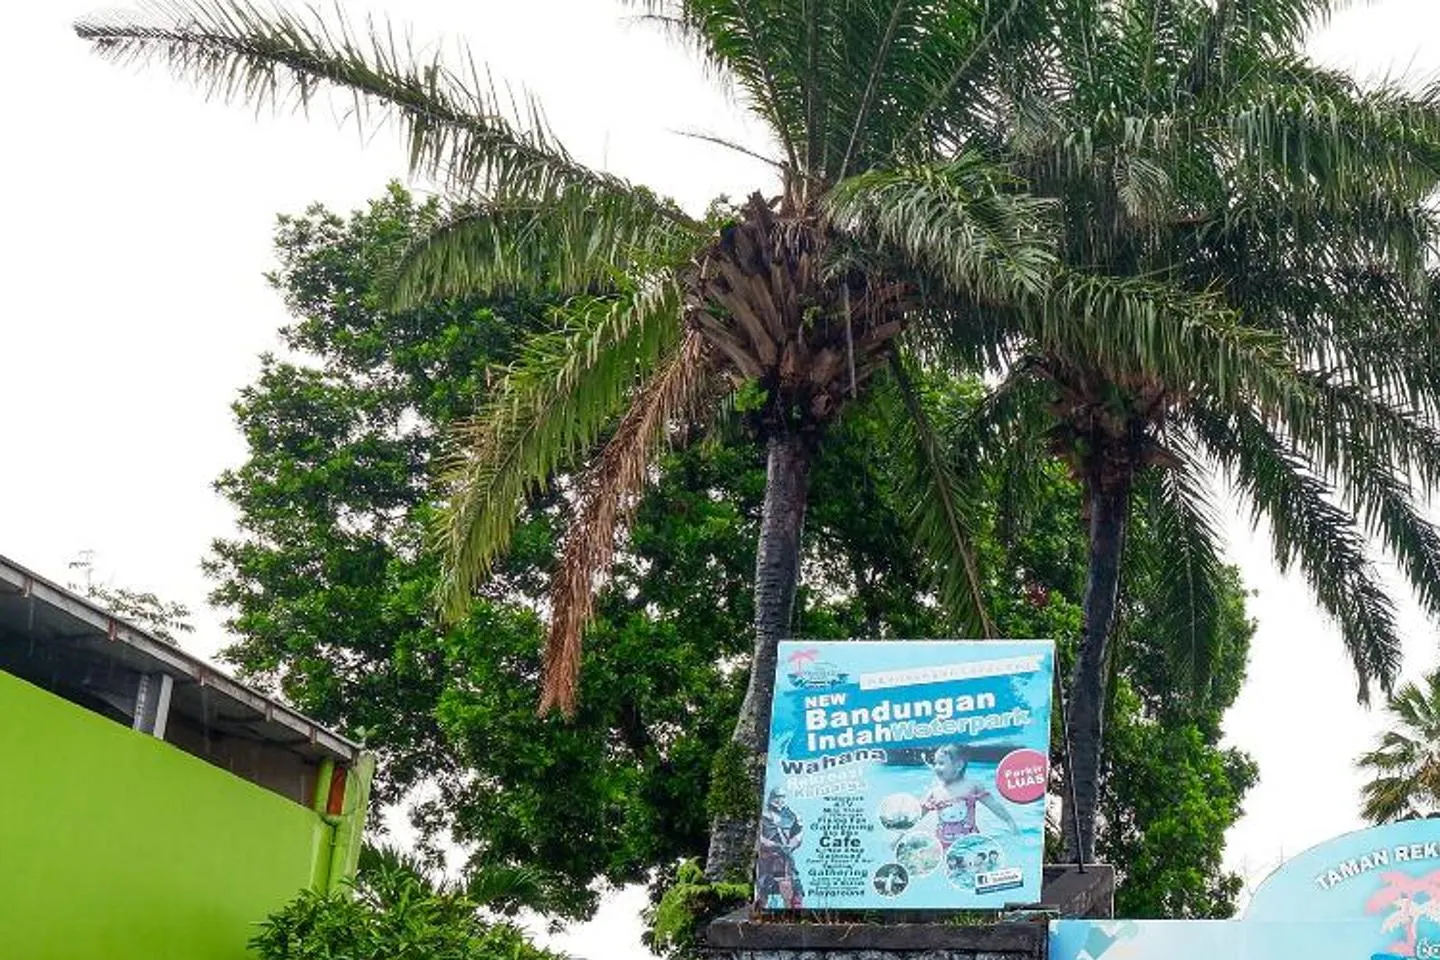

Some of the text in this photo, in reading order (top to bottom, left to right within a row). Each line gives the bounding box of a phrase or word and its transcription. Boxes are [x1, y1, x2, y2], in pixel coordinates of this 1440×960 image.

[805, 693, 847, 709] NEW
[805, 692, 996, 731] Bandungan
[807, 721, 894, 752] Indah
[781, 748, 886, 775] Wahana
[1007, 776, 1046, 790] LUAS
[819, 836, 862, 848] Cafe
[1314, 849, 1390, 891] TAMAN
